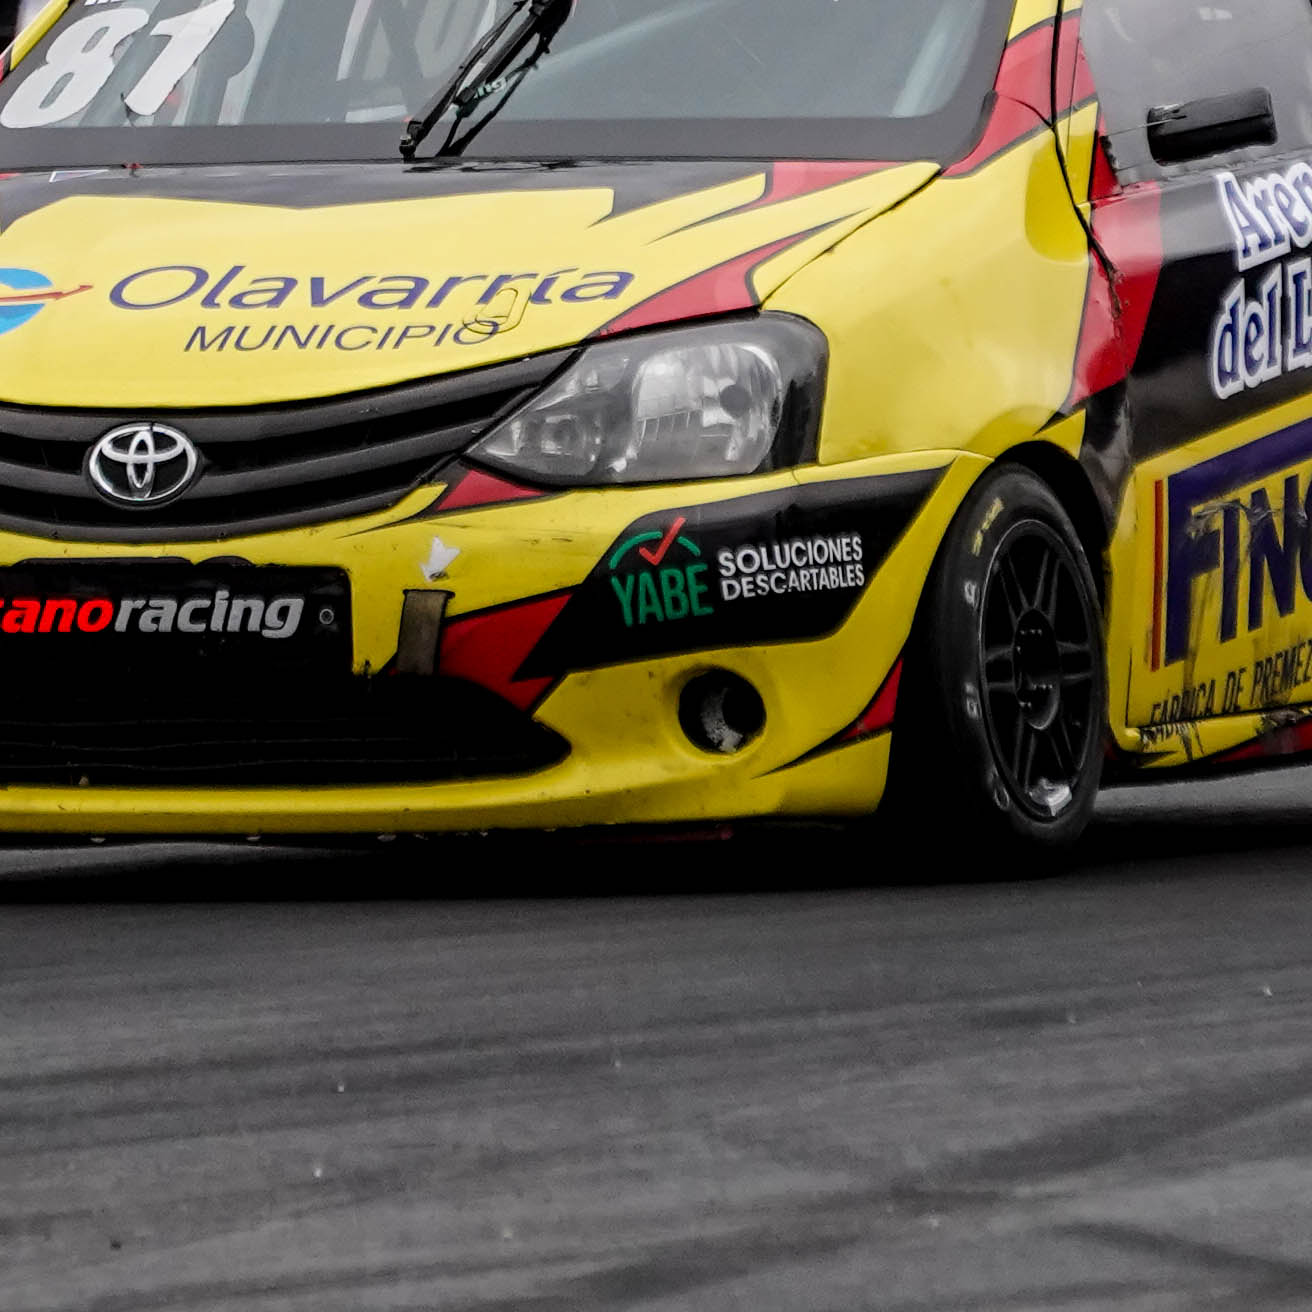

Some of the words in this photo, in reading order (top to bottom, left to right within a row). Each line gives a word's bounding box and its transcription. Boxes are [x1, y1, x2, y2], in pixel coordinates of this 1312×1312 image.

[109, 265, 637, 310] Olavarría
[183, 320, 501, 353] MUNICIPIO
[1213, 263, 1282, 399] del
[718, 535, 863, 578] SOLUCIONES
[611, 563, 715, 628] YABE
[720, 563, 866, 602] DESCARTABLES
[1225, 666, 1247, 715] DE
